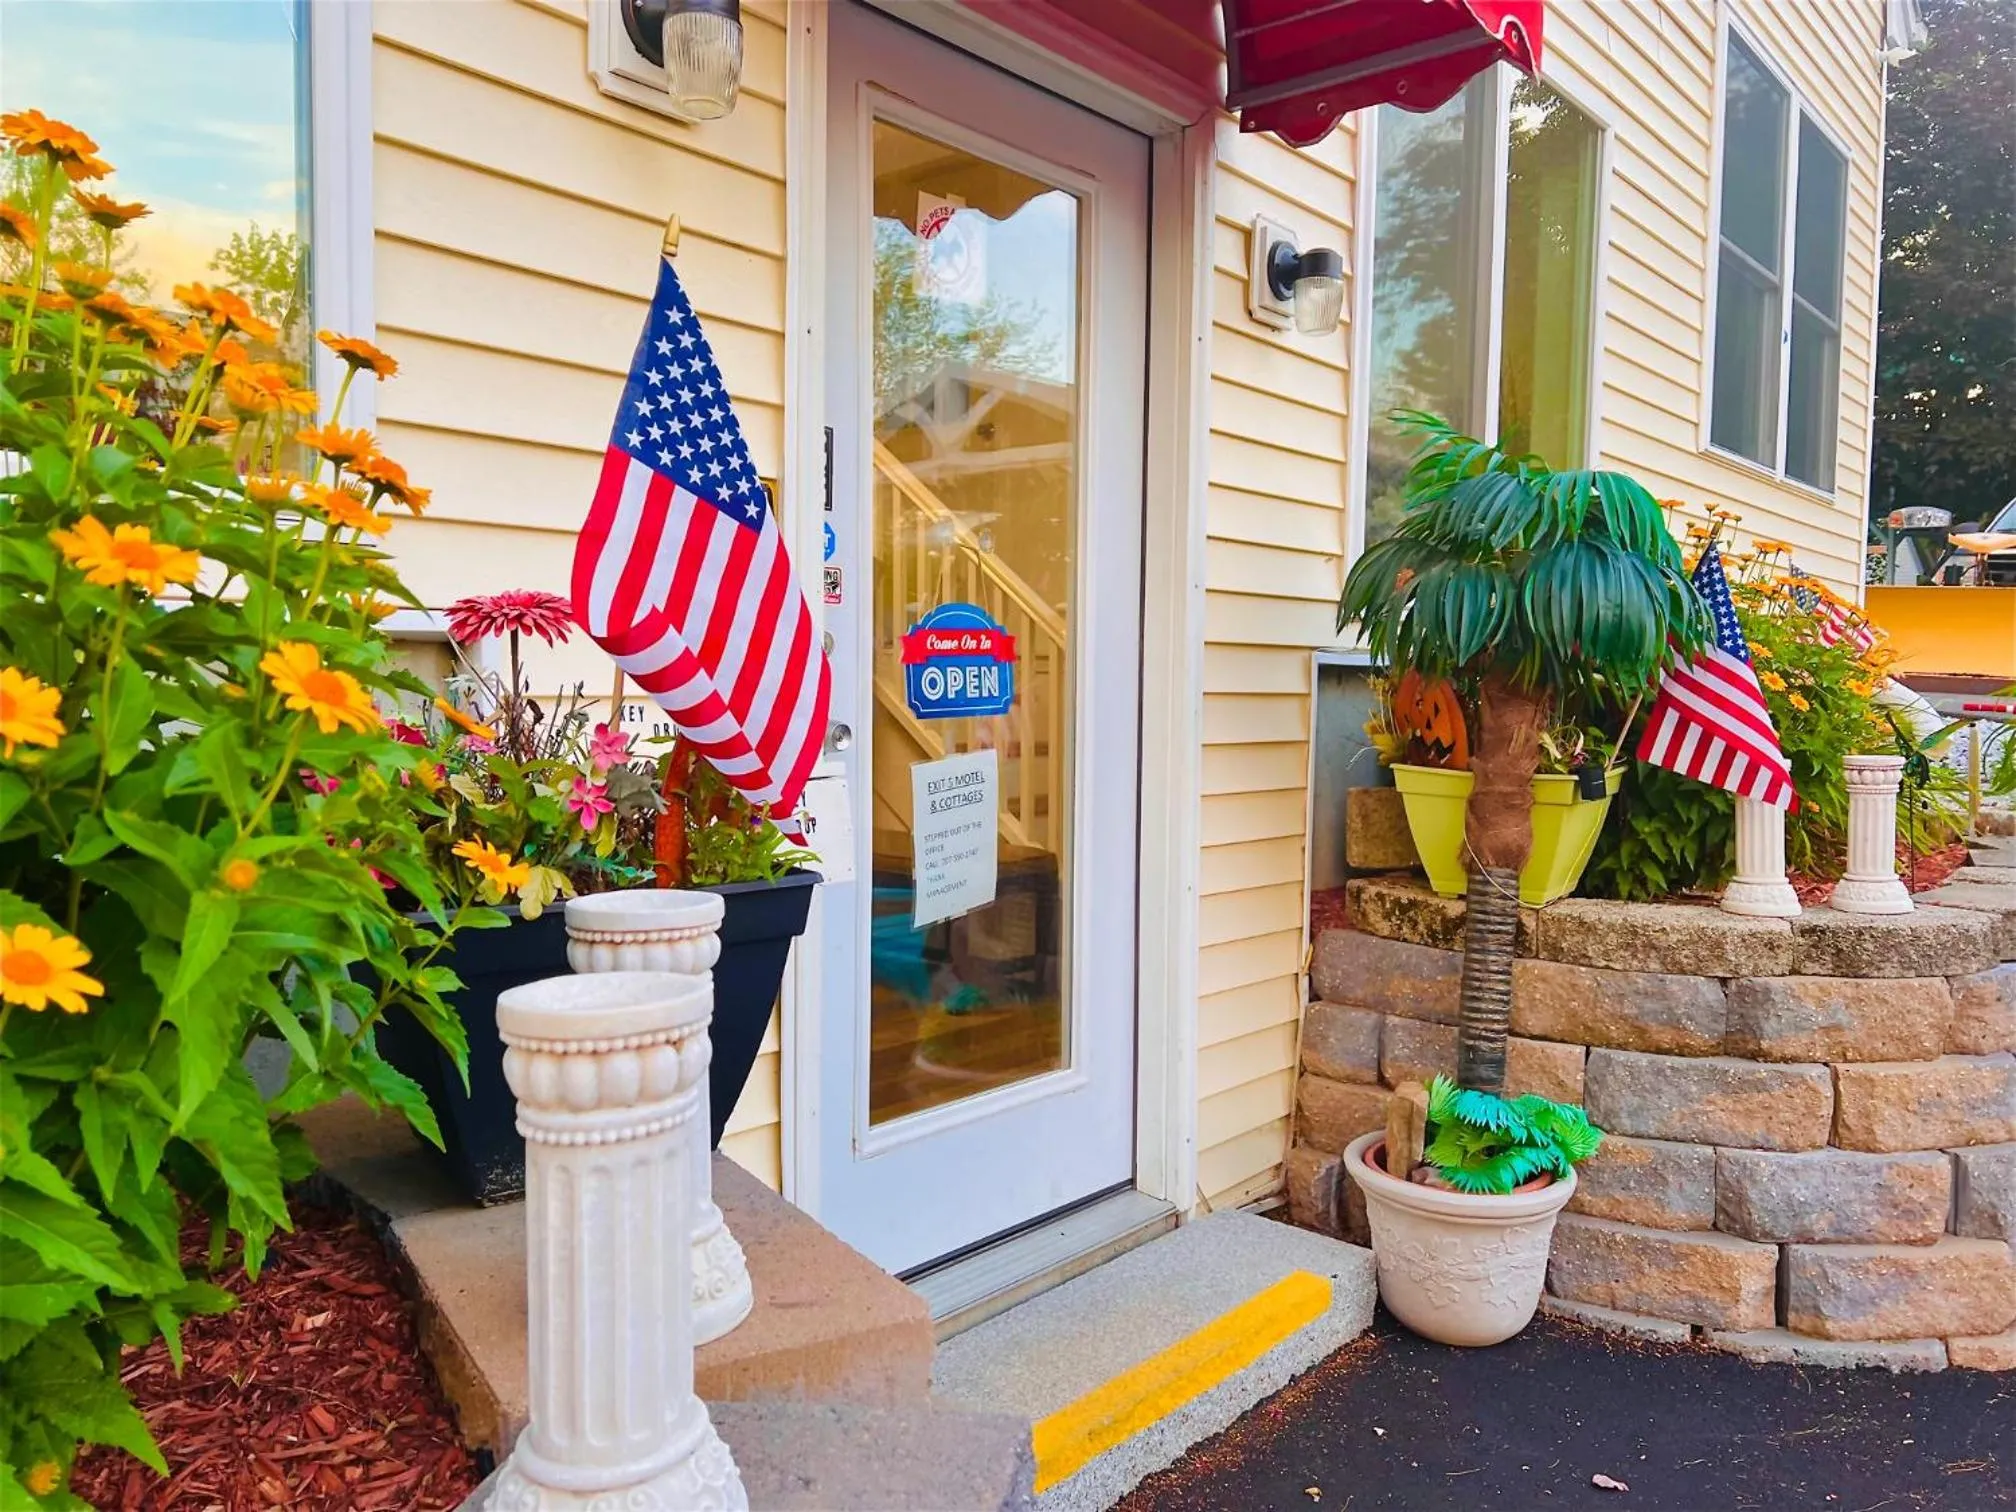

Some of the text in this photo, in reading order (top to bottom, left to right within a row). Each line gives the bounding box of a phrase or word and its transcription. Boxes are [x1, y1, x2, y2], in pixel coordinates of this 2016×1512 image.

[920, 219, 930, 236] NO
[929, 206, 949, 221] PETS
[926, 634, 992, 650] Come On In
[921, 666, 999, 701] OPEN
[619, 705, 645, 722] KEY
[928, 778, 945, 793] EXIT
[955, 770, 985, 786] MOTEL
[939, 789, 984, 809] COTTAGES
